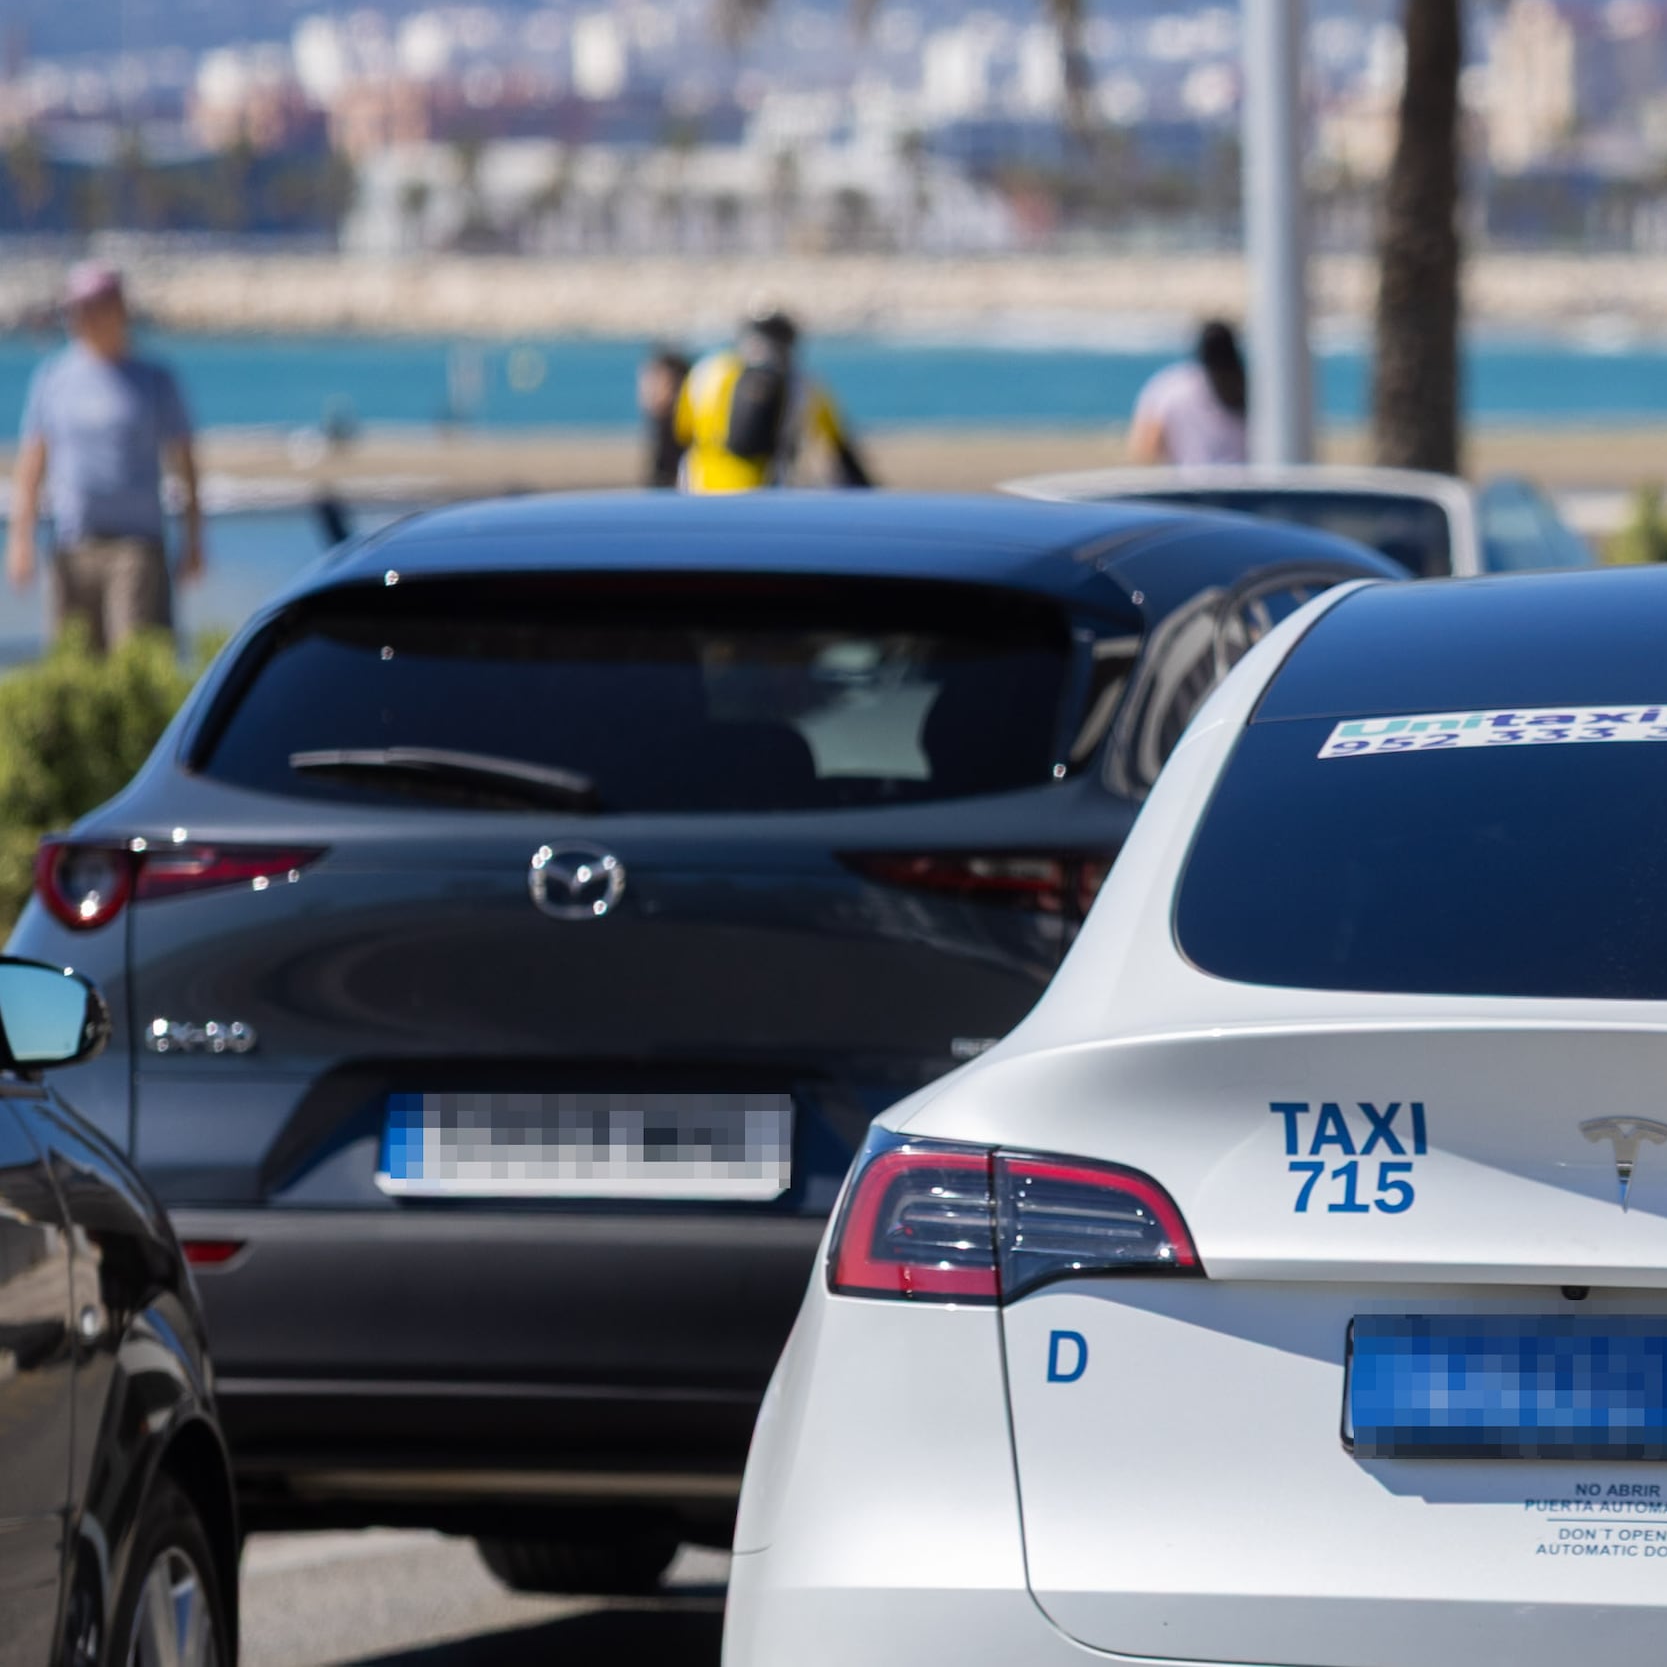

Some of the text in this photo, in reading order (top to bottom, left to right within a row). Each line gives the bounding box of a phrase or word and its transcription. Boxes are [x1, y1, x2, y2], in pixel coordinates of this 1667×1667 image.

[1338, 708, 1661, 738] Unitaxi
[1330, 733, 1459, 756] 952
[1488, 726, 1613, 744] 333
[1269, 1102, 1427, 1156] TAXI
[1288, 1160, 1415, 1214] 715
[1047, 1330, 1088, 1383] D
[1575, 1483, 1661, 1497] NO ABRIR
[1524, 1499, 1594, 1512] PUERTA
[1618, 1529, 1667, 1541] OPEN
[1536, 1544, 1638, 1557] AUTOMATIC
